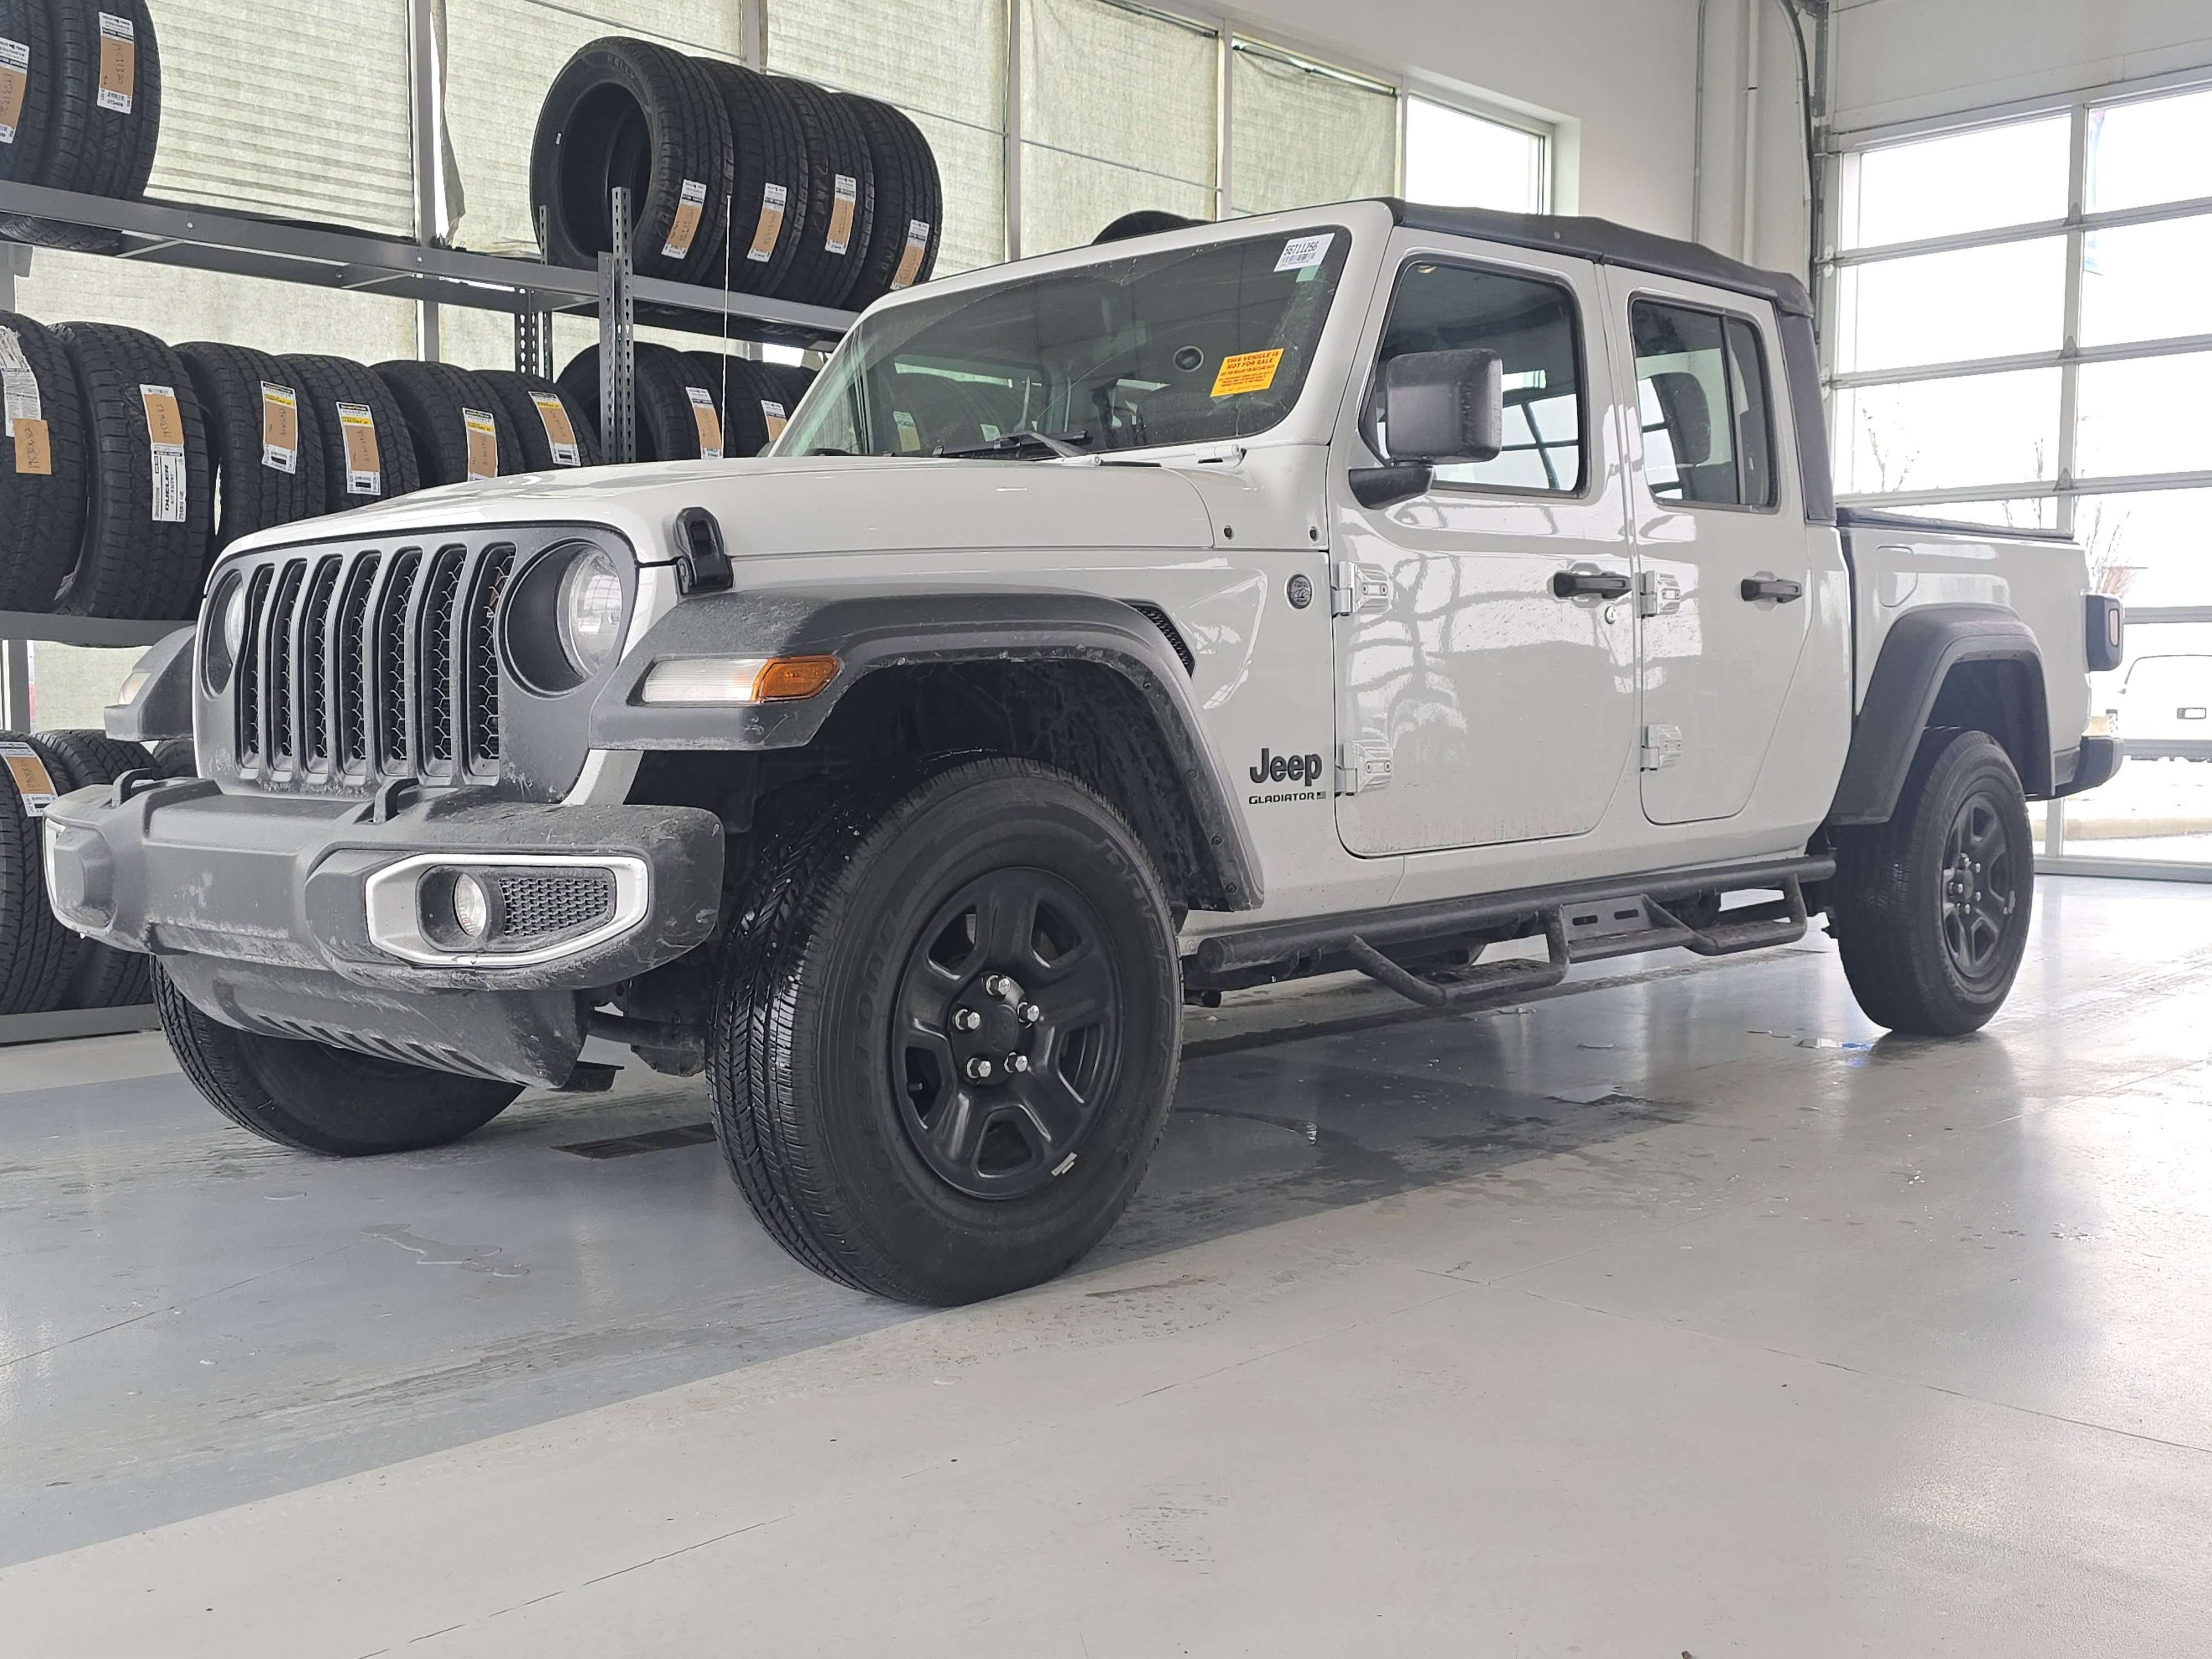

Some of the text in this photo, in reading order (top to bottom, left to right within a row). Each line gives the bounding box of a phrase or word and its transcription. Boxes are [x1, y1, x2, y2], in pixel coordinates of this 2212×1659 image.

[607, 54, 636, 79] KELLY
[1244, 352, 1272, 361] VEHICLE
[1250, 748, 1322, 786] Jeep
[1249, 792, 1314, 805] GLADIATOR
